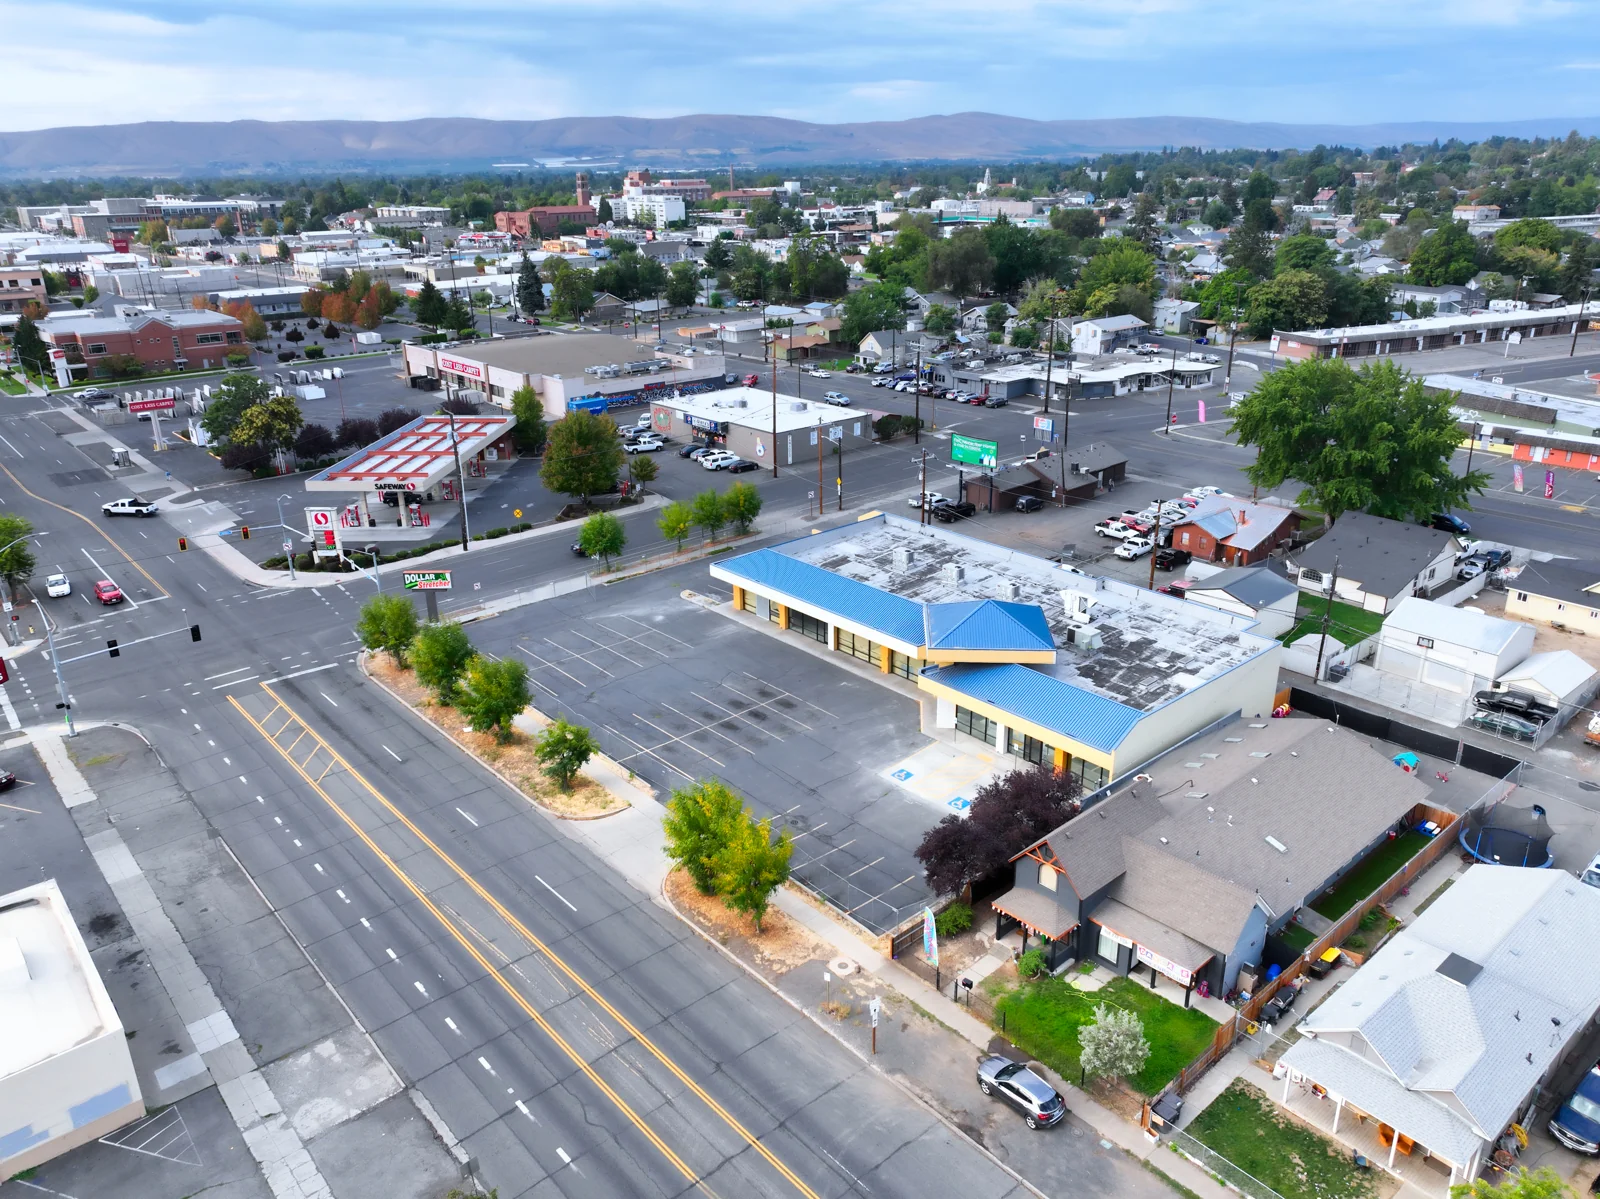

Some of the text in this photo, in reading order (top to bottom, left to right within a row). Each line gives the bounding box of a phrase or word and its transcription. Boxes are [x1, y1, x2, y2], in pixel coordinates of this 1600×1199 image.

[442, 360, 453, 369] COST
[463, 365, 479, 376] CARPET
[404, 573, 436, 585] DOLLAR
[418, 579, 450, 589] Stretcher
